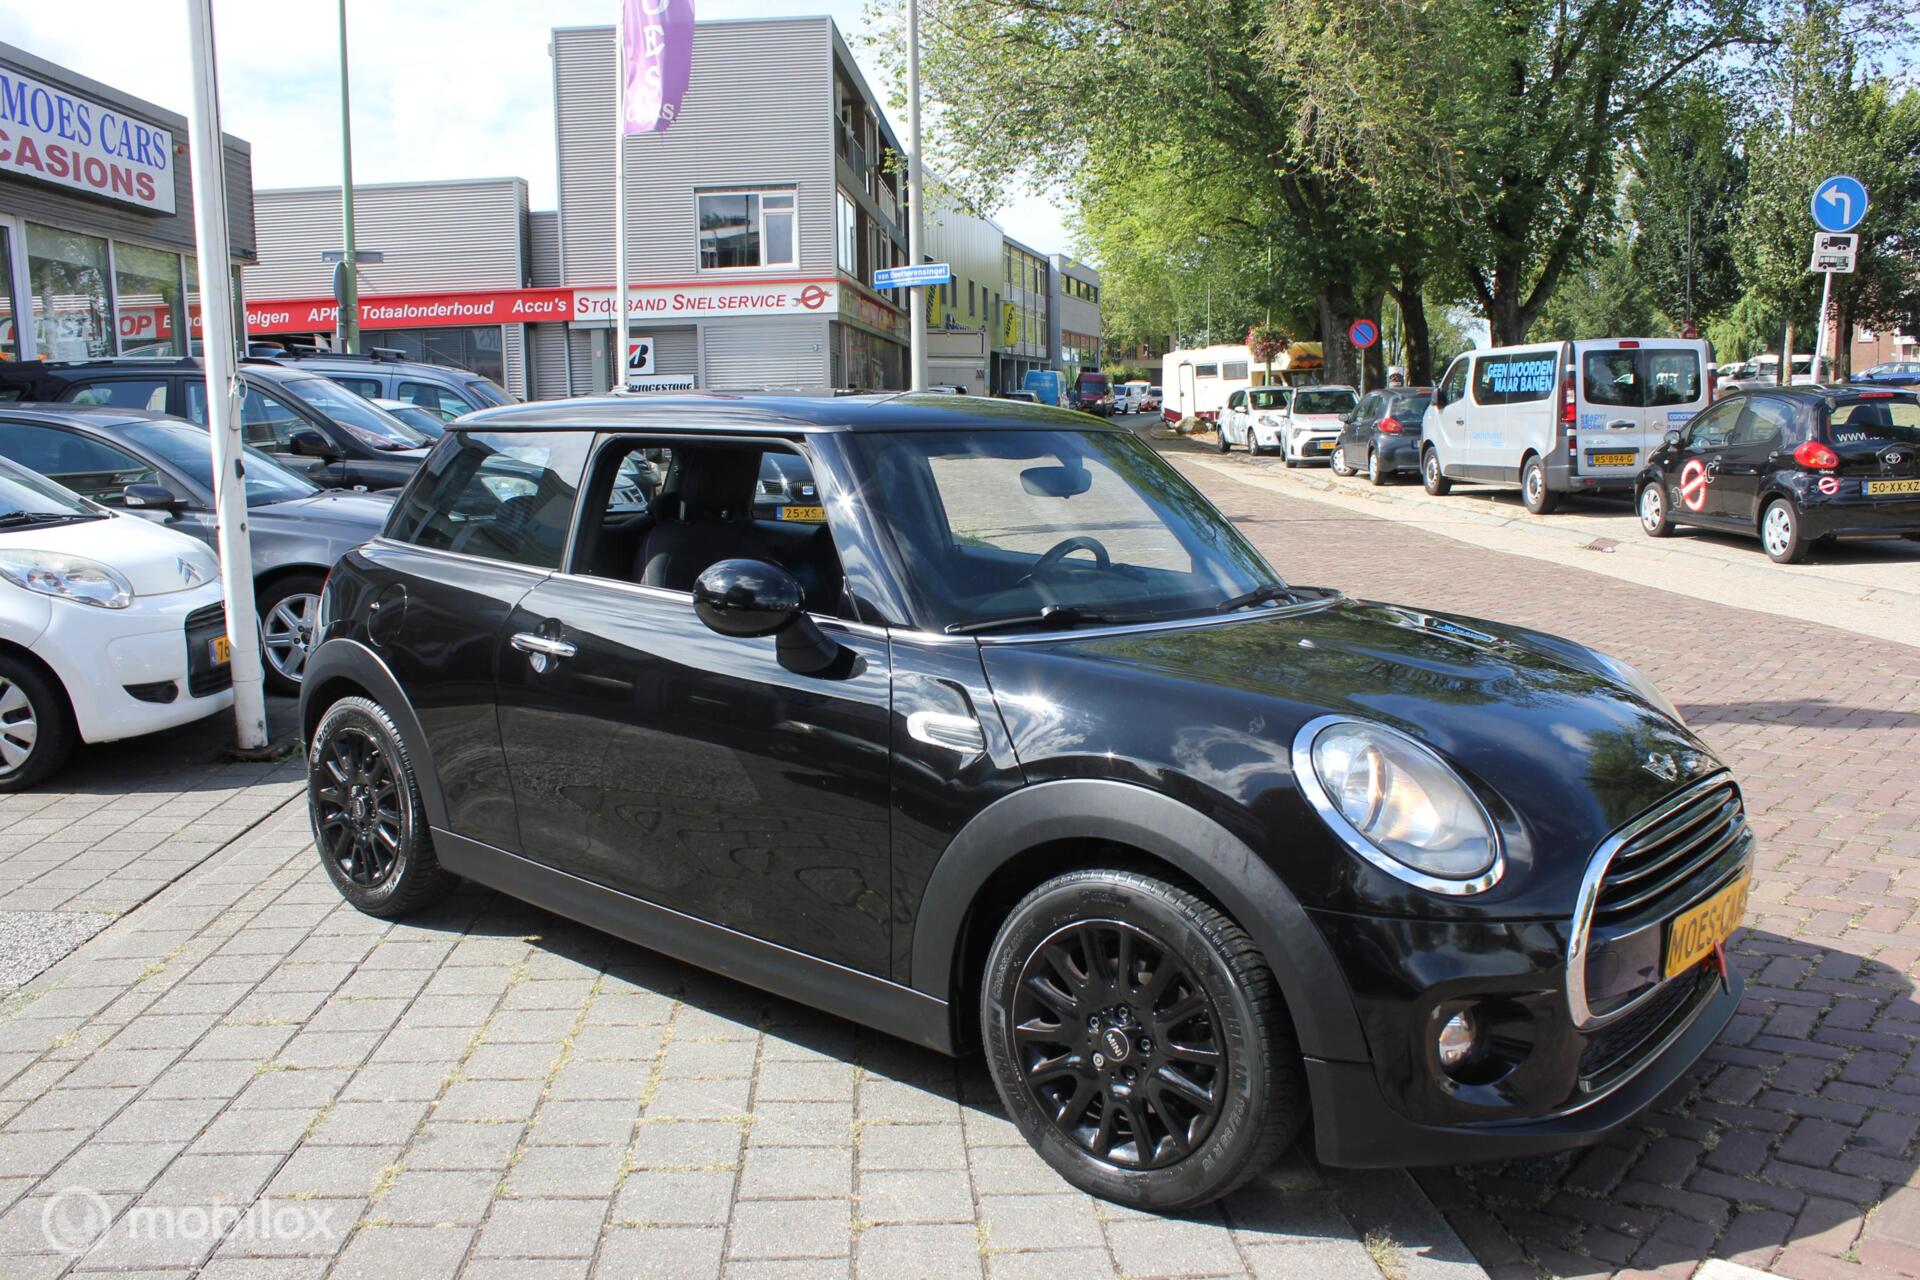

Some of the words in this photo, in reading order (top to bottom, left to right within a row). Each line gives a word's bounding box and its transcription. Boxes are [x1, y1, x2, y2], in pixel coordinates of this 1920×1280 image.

[0, 74, 92, 147] MOES
[100, 112, 167, 170] CARS
[246, 310, 290, 328] elgen
[361, 300, 495, 320] Totaalonderhoud
[512, 297, 567, 314] Accu's
[1487, 363, 1509, 378] GEEN
[1509, 360, 1554, 377] WOORDEN
[1494, 377, 1519, 392] MAAR
[1519, 375, 1553, 392] BANEN
[1106, 1033, 1123, 1057] MINI
